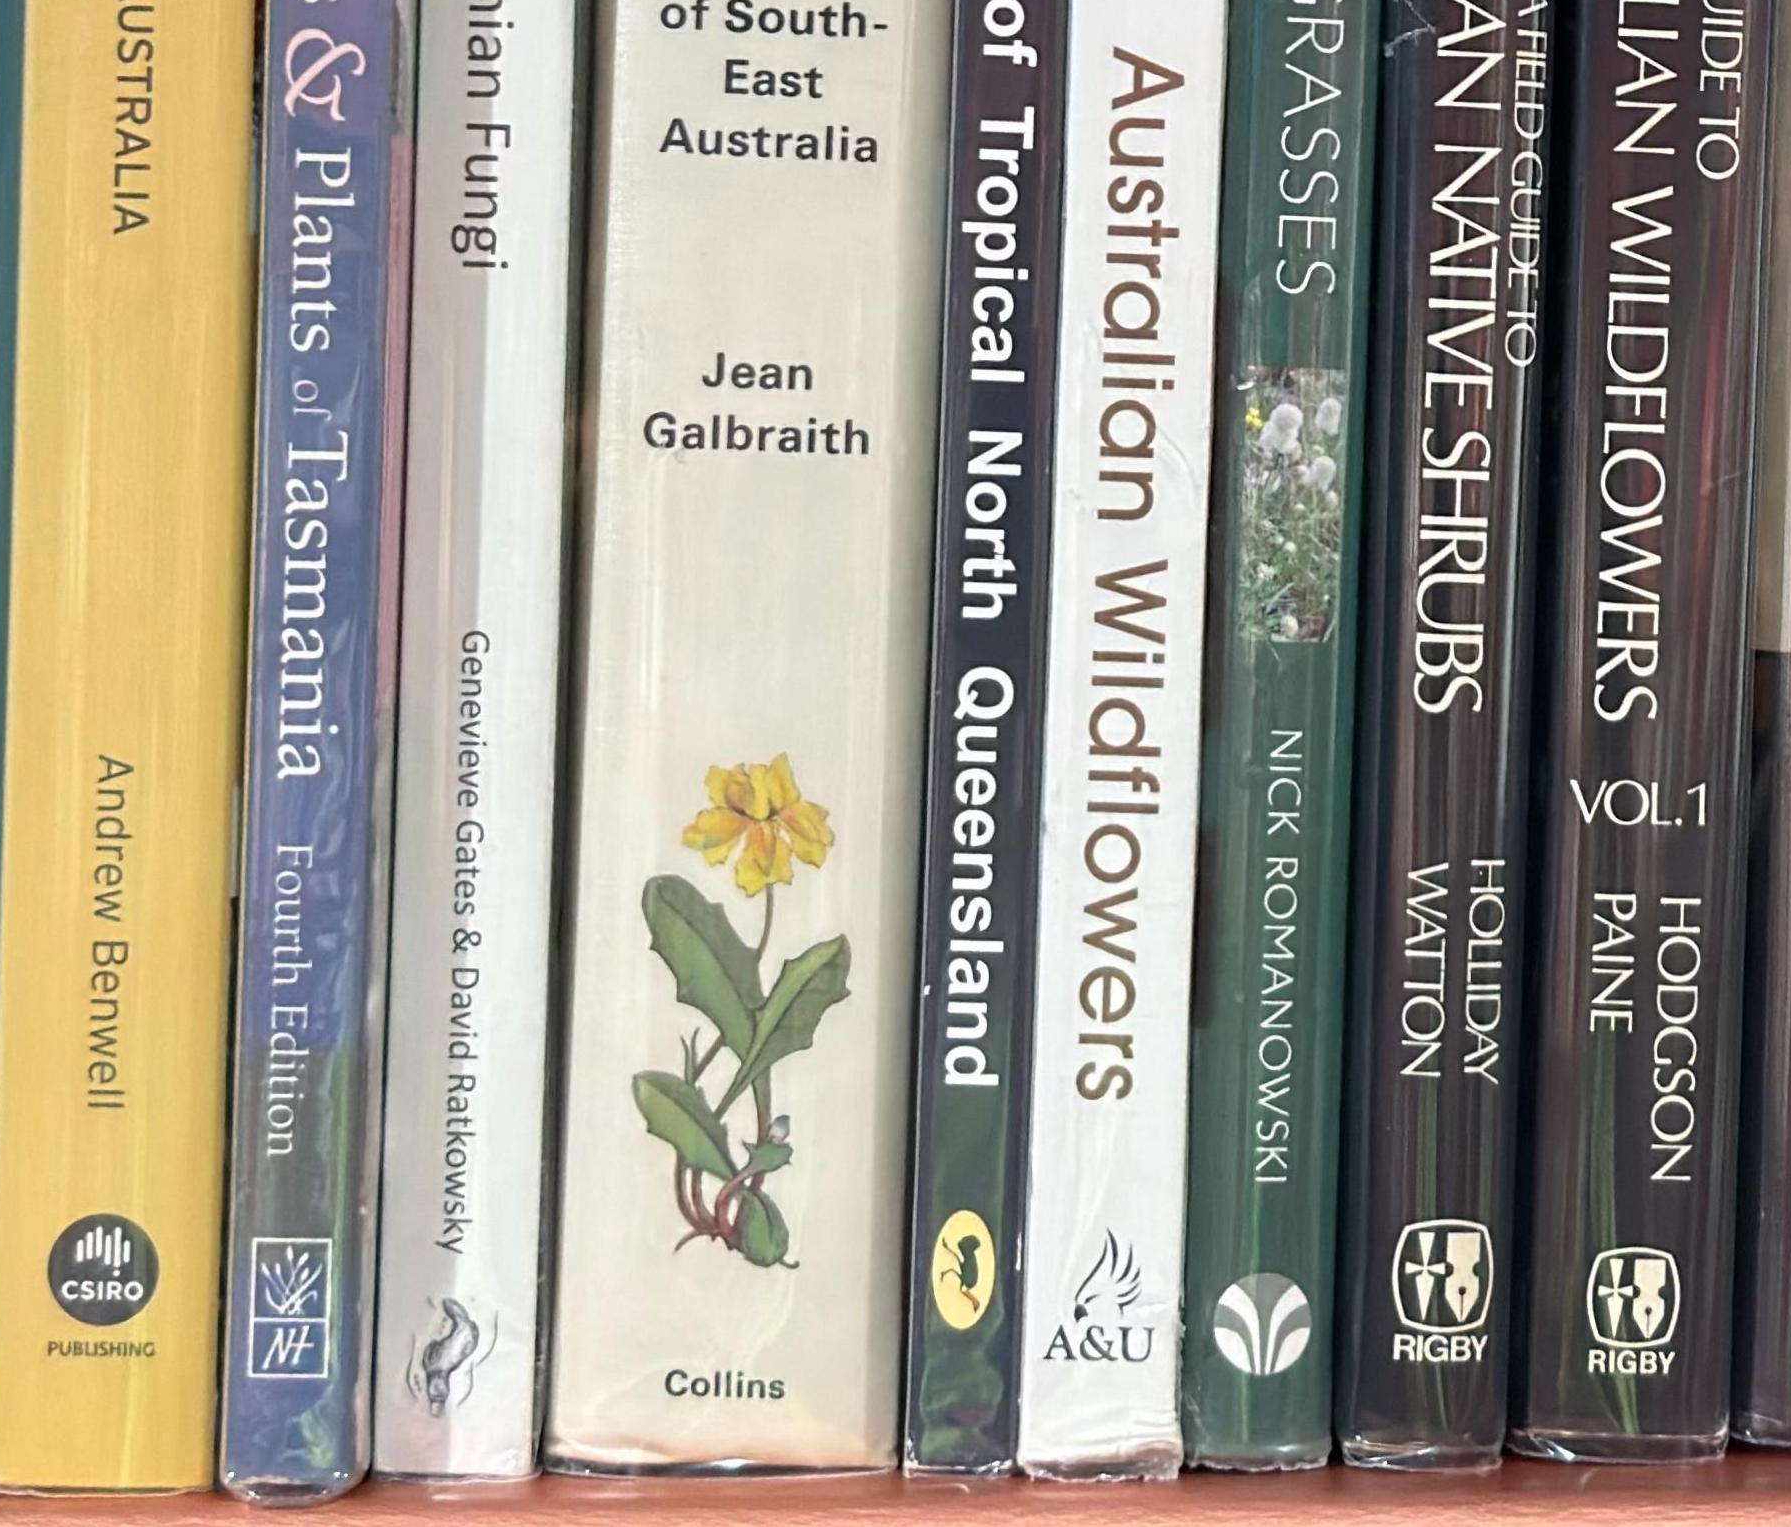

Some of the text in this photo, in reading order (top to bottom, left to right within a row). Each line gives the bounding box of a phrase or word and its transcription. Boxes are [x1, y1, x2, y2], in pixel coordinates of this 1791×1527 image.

[285, 28, 367, 121] &
[658, 119, 880, 164] Australia
[723, 60, 823, 101] East
[1697, 105, 1740, 180] TO
[290, 146, 355, 352] Plants
[451, 122, 511, 270] Fungi
[962, 106, 1035, 384] Tropical
[1424, 143, 1502, 410] NATIVE
[291, 378, 331, 421] of
[643, 412, 870, 457] Galbraith
[701, 352, 813, 392] Jean
[962, 429, 1024, 621] North
[1594, 185, 1674, 723] WILDFLOWERS
[276, 429, 348, 780] Tasmania
[1074, 46, 1186, 1101] Australian Wildflowers
[1413, 427, 1493, 714] SHRUBS
[87, 753, 135, 1110] Andrew Benwell
[272, 843, 313, 987] Fourth
[435, 630, 490, 1256] Genevieve Gates & David Ratkowsky
[944, 666, 1014, 1087] Queensland
[1255, 728, 1302, 1184] NICK ROMANOWSKI
[1400, 863, 1450, 1079] WATTON
[1462, 859, 1506, 1085] HOLLIDAY
[1588, 892, 1637, 1035] PAINE
[266, 1002, 309, 1158] Edition
[1649, 896, 1702, 1182] HODGSON
[47, 1341, 156, 1358] PUBLISHING
[61, 1278, 144, 1303] CSIRO
[1043, 1326, 1156, 1362] A&U
[1393, 1333, 1488, 1362] RIGBY
[1587, 1349, 1675, 1376] RIGBY
[664, 1369, 785, 1402] Collins
